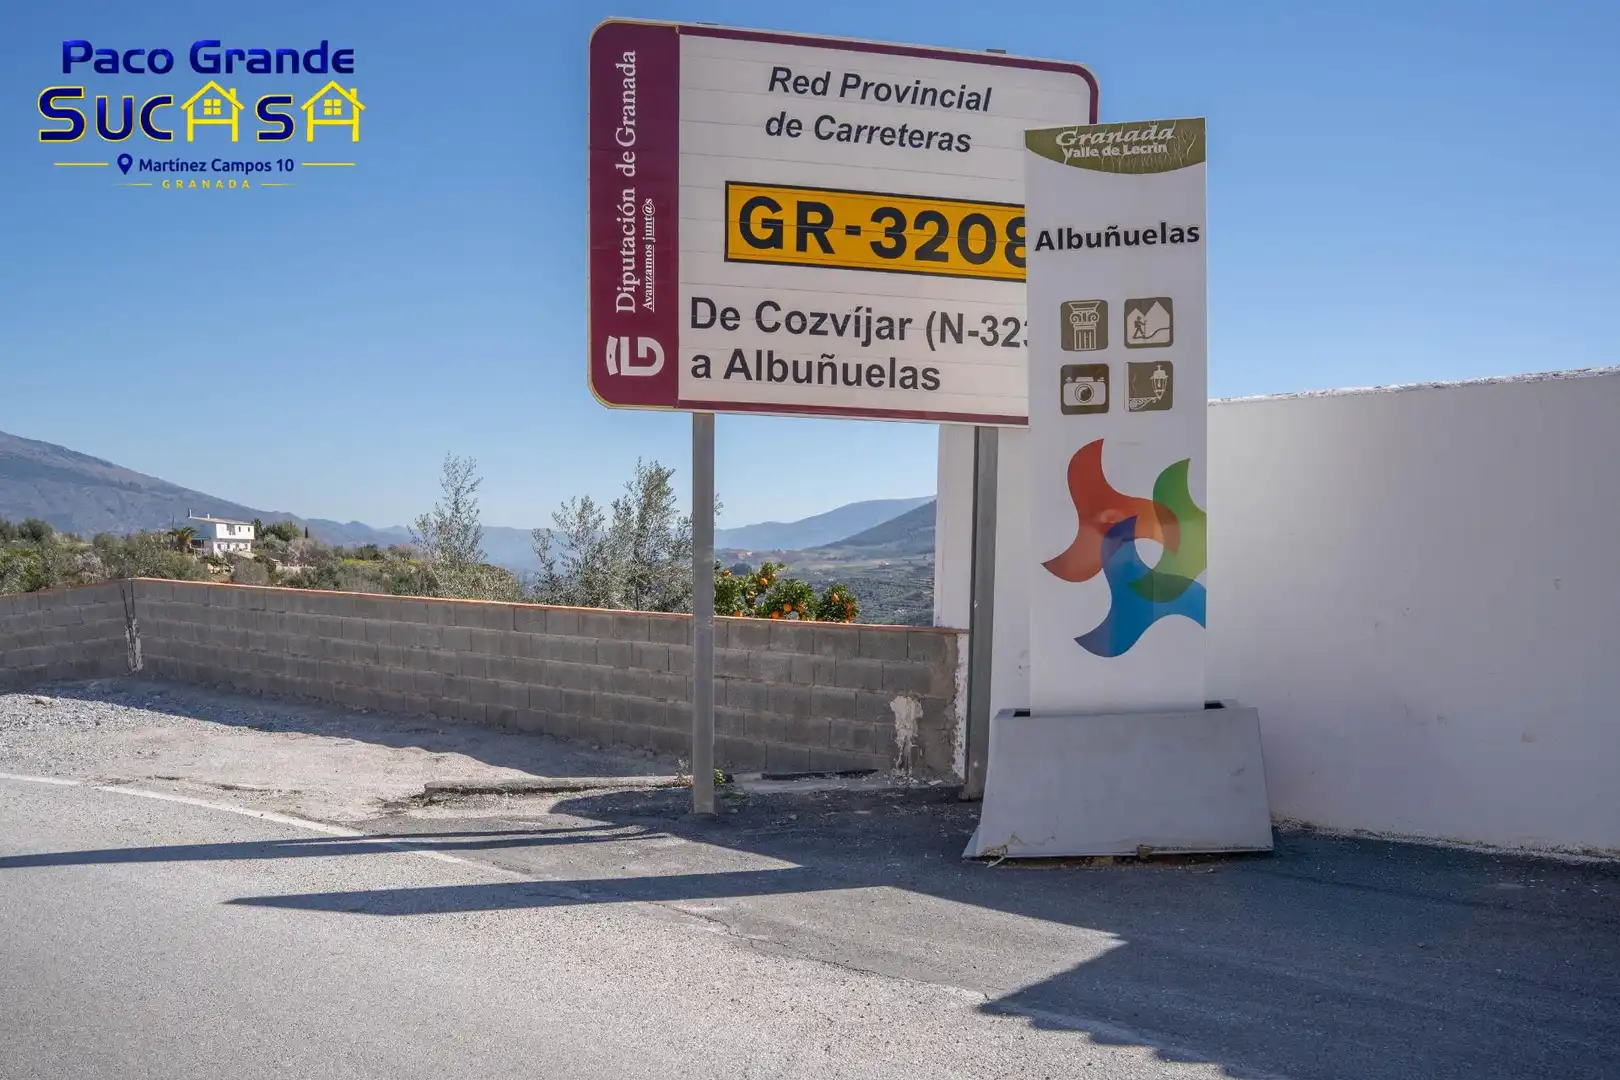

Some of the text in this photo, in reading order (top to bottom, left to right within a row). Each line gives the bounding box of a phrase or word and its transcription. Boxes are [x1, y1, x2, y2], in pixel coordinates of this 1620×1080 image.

[768, 66, 993, 112] Red Provincial
[765, 111, 972, 153] de Carreteras
[1055, 120, 1177, 146] Granada
[1062, 145, 1099, 161] Valle
[1101, 144, 1120, 157] de
[615, 50, 641, 313] Diputación de Granada
[642, 198, 656, 313] Avanzamos junt@s
[1034, 221, 1201, 252] Albuñuelas
[690, 296, 1028, 352] De Cozvíjar (N-32
[690, 348, 941, 391] a Albuñuelas
